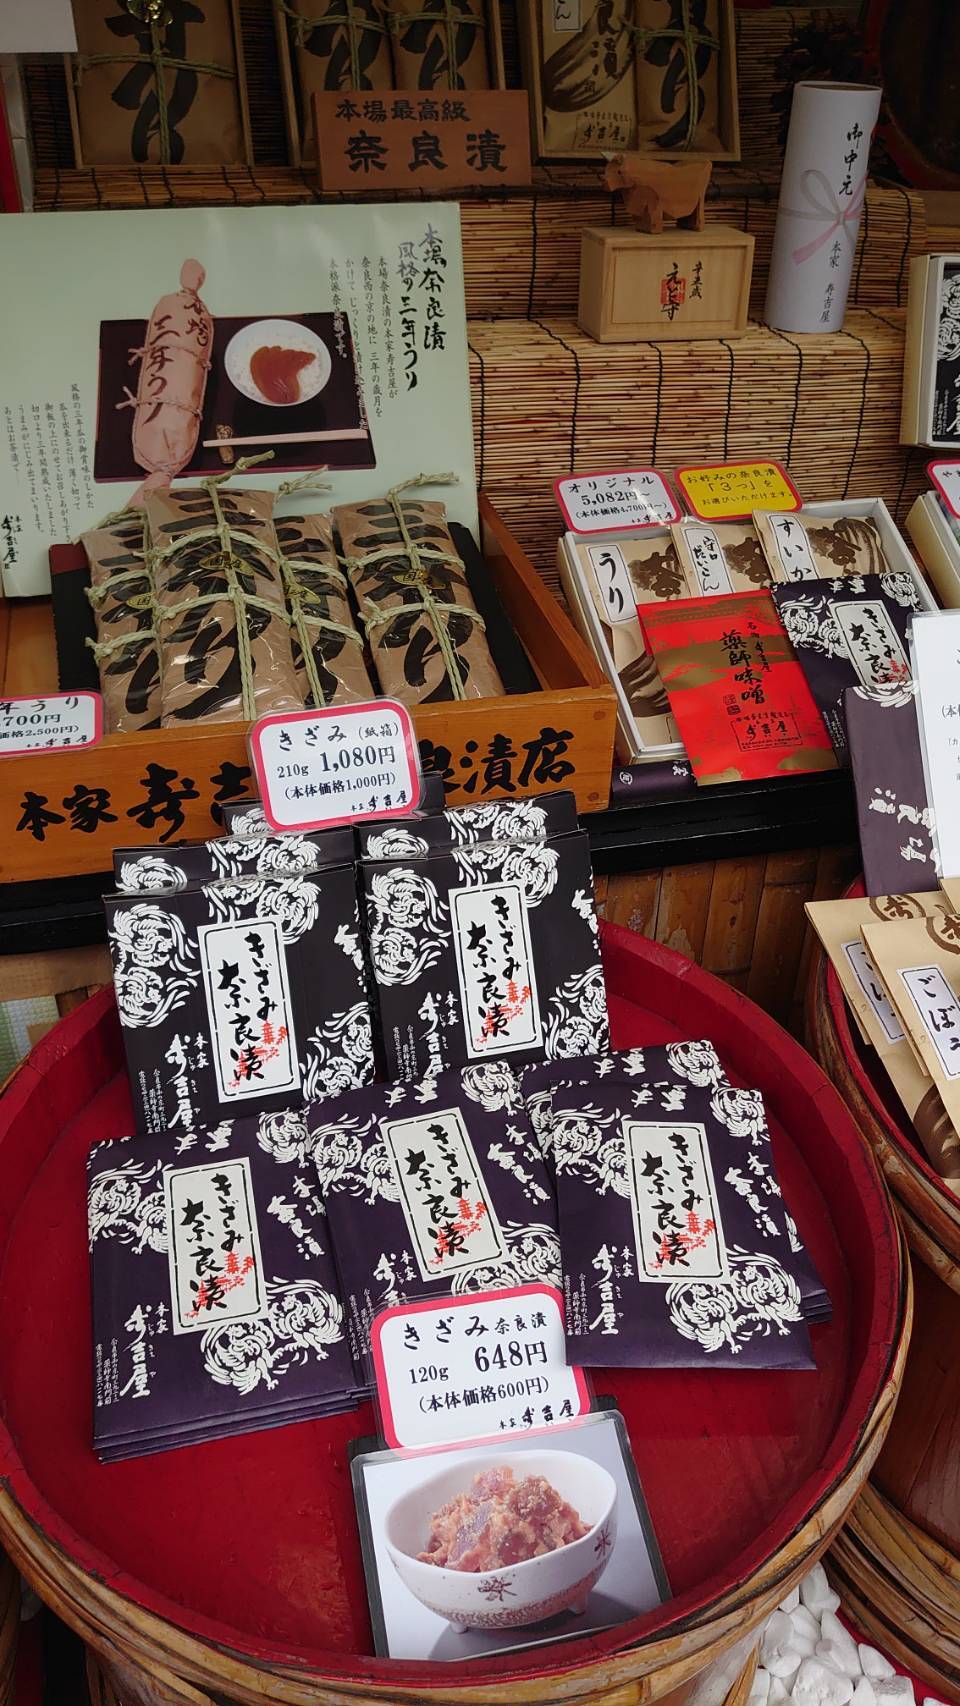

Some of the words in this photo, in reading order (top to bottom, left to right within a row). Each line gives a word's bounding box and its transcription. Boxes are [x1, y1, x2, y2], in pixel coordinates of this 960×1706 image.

[335, 99, 471, 122] 本場最高級
[343, 129, 508, 174] 奈良漬
[838, 122, 863, 196] 御中元
[829, 240, 842, 268] 本家
[397, 240, 420, 391] 風格の三年うり
[419, 223, 448, 351] 本場奈良漬
[820, 283, 835, 323] 寿吉屋
[568, 476, 655, 494] オリジナル
[686, 468, 776, 485] お好みの奈良漬
[701, 490, 794, 506] お選びいただけます。
[692, 544, 721, 593] だいこん
[703, 536, 719, 561] 守口
[777, 518, 813, 583] すいか
[598, 551, 626, 615] うり
[861, 607, 897, 659] きざみ
[720, 629, 766, 704] 薬師味噌
[277, 764, 310, 779] 210g
[320, 745, 396, 773] 1,080円
[284, 772, 397, 801] (本体価格1,000円)
[490, 894, 522, 980] きざみ
[244, 931, 279, 1022] きざみ
[467, 921, 510, 1038] 奈良漬
[217, 959, 266, 1082] 奈良漬
[445, 990, 460, 1027] 本家
[193, 1032, 210, 1069] 本家
[164, 1033, 194, 1130] 寿吉屋
[427, 1123, 472, 1197] きざみ
[667, 1132, 704, 1212] きざみ
[210, 1173, 245, 1252] きざみ
[404, 1148, 469, 1257] 奈良漬
[640, 1152, 691, 1267] 奈良漬
[180, 1198, 228, 1311] 奈良漬
[400, 1250, 418, 1281] 本家
[620, 1246, 635, 1277] 本家
[155, 1302, 170, 1334] 本家
[590, 1243, 619, 1335] 寿吉屋
[119, 1304, 151, 1398] 寿吉屋
[408, 1366, 449, 1385] 120g
[474, 1340, 549, 1374] 648円
[418, 1375, 550, 1414] (本体価格600円)
